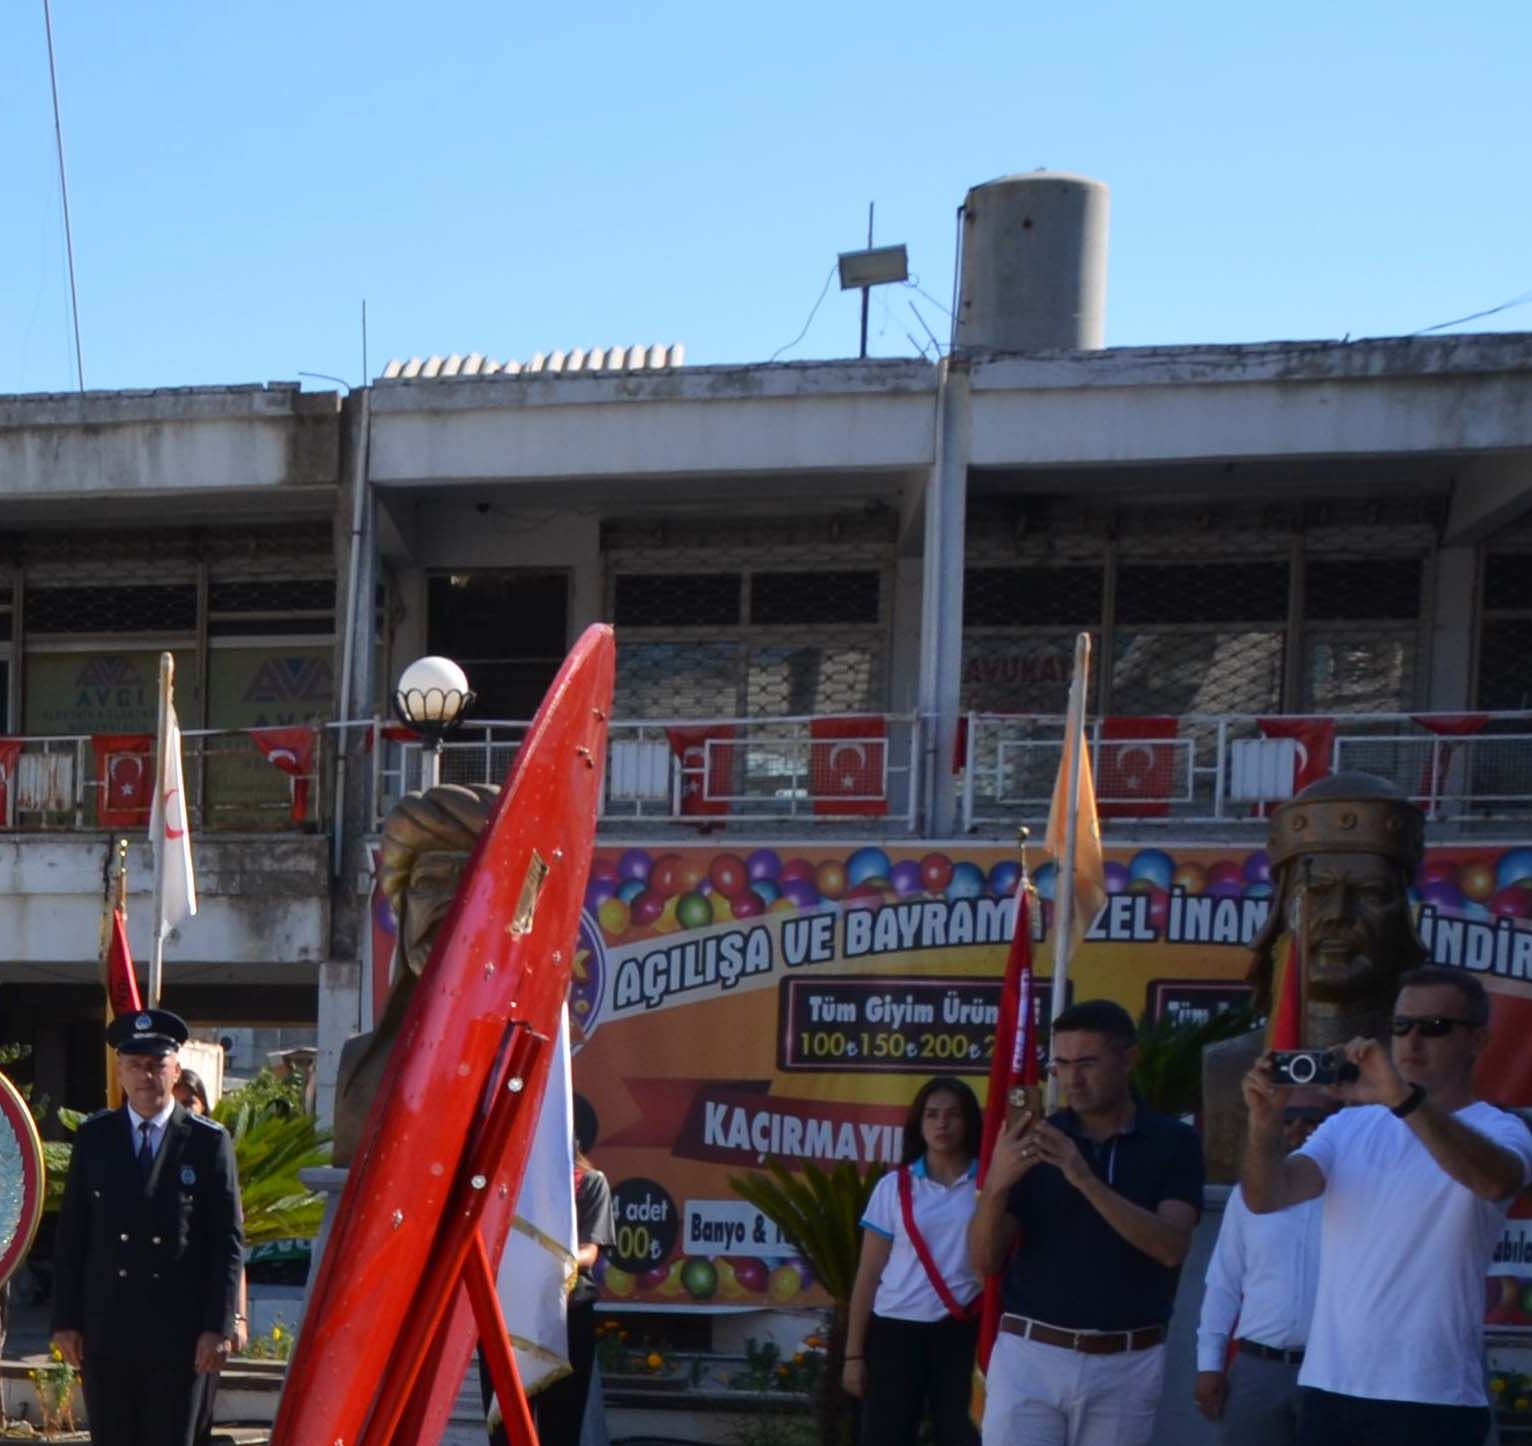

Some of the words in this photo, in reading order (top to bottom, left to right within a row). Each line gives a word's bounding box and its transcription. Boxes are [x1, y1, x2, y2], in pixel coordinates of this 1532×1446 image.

[614, 925, 772, 1010] AÇILIŞA
[781, 911, 836, 967] VE
[809, 995, 856, 1023] Tüm
[865, 995, 934, 1030] Giyim
[625, 1192, 668, 1222] adet
[691, 1212, 746, 1250] Banyo
[752, 1213, 766, 1243] &
